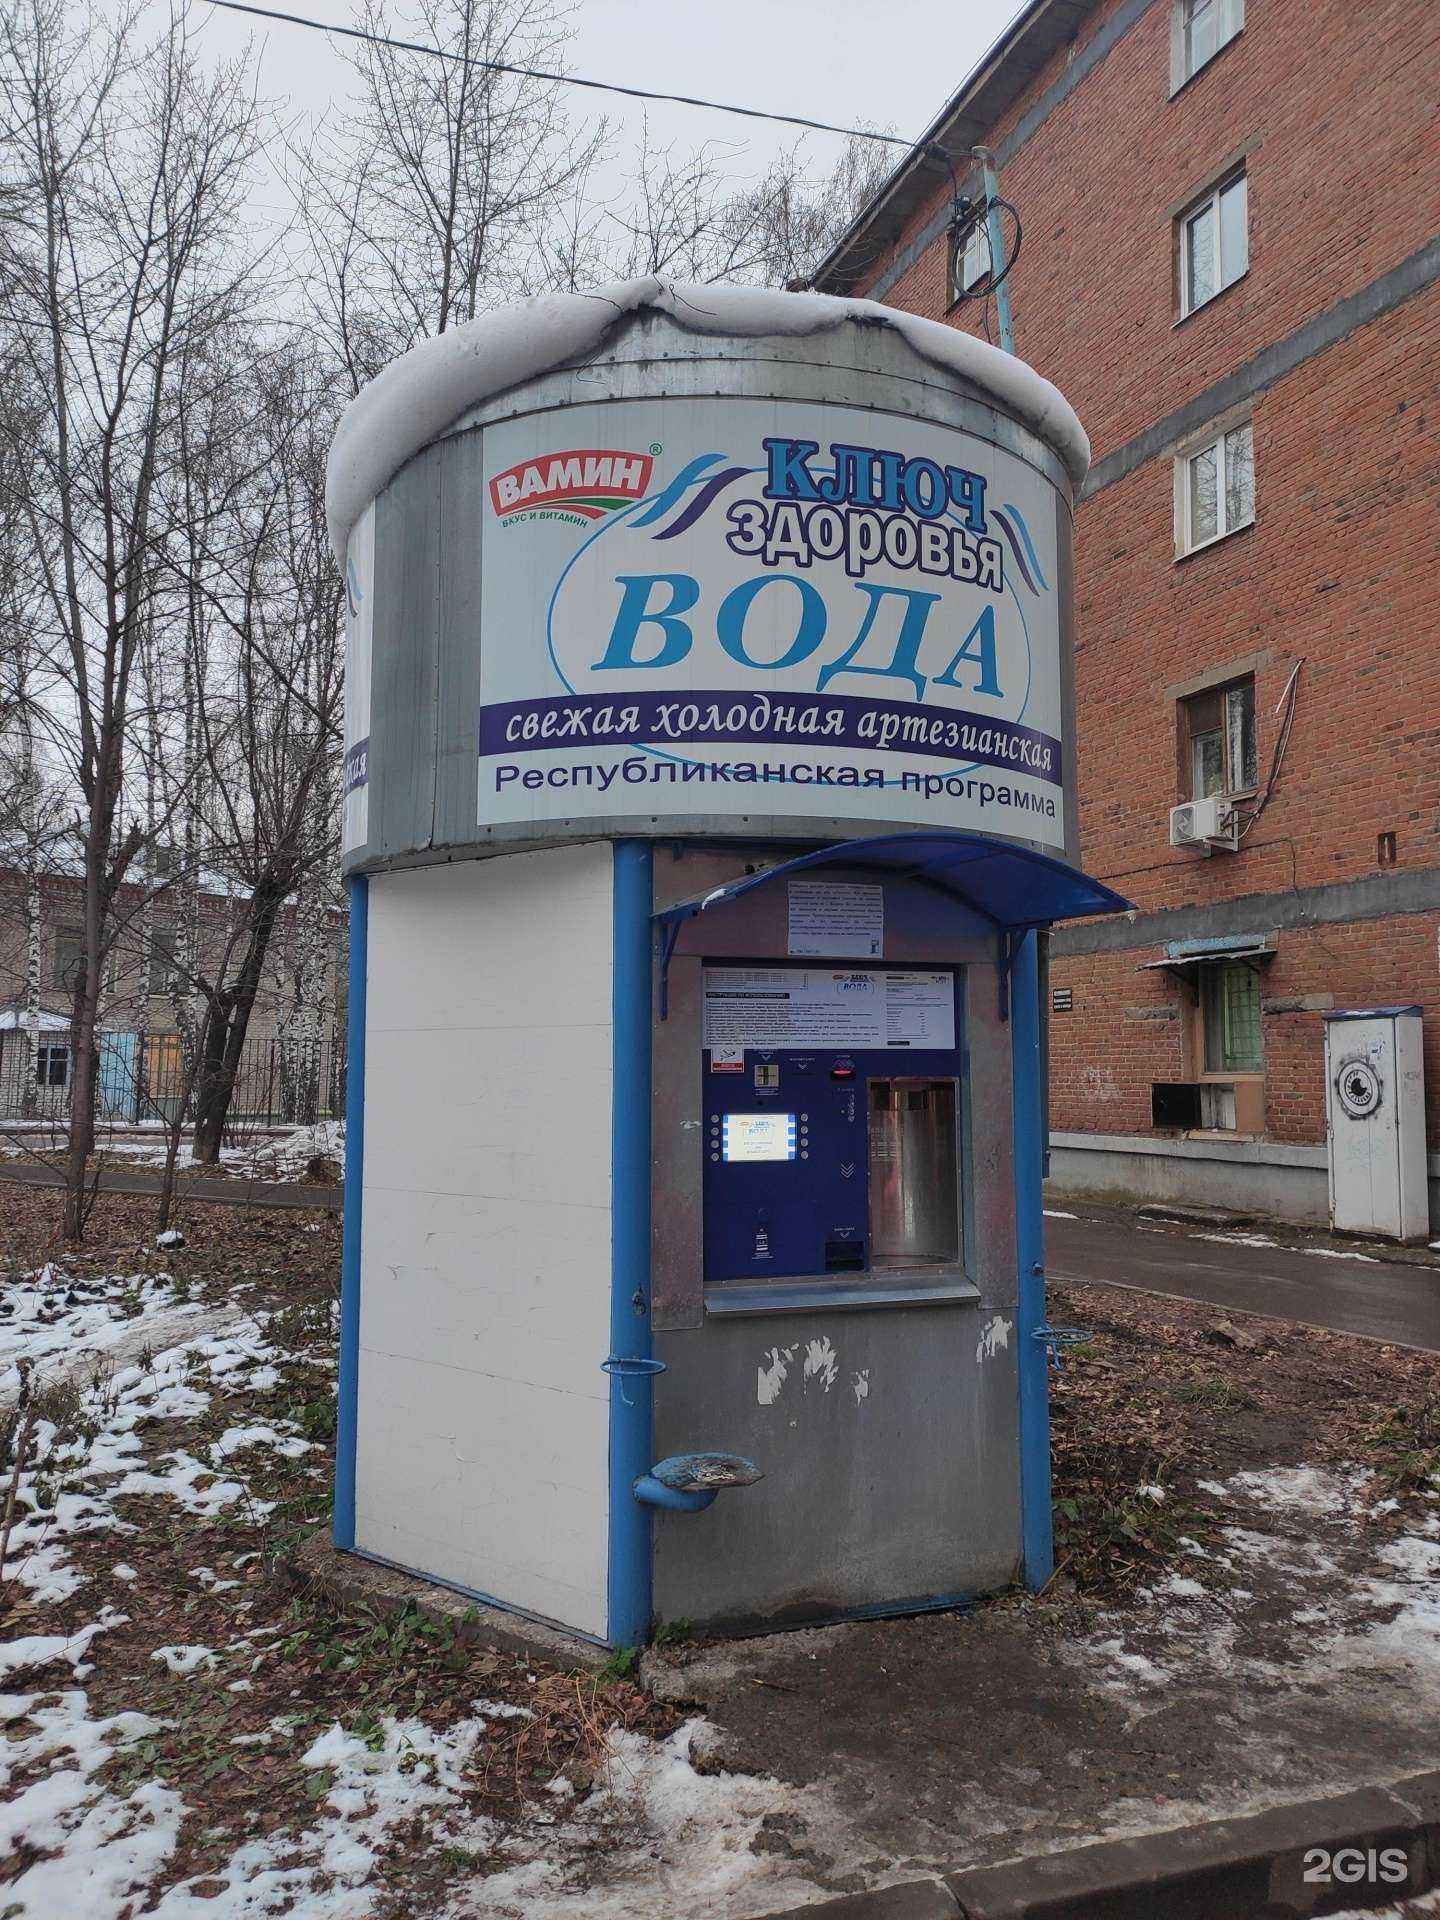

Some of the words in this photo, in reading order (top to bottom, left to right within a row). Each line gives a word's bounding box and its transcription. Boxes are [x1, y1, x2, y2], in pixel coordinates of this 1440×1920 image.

[496, 457, 643, 508] ВАМИН
[502, 513, 527, 527] ВКУС
[539, 512, 588, 528] ВИТАМИН
[762, 438, 987, 534] КЛЮЧ
[726, 500, 1004, 592] ЗДОРОВЬЯ
[591, 573, 1003, 701] ВОДА
[505, 704, 640, 742] свежая
[650, 694, 846, 738] холодная
[856, 711, 1052, 773] артезианская
[495, 758, 885, 792] Республиканская
[901, 770, 1056, 818] программа
